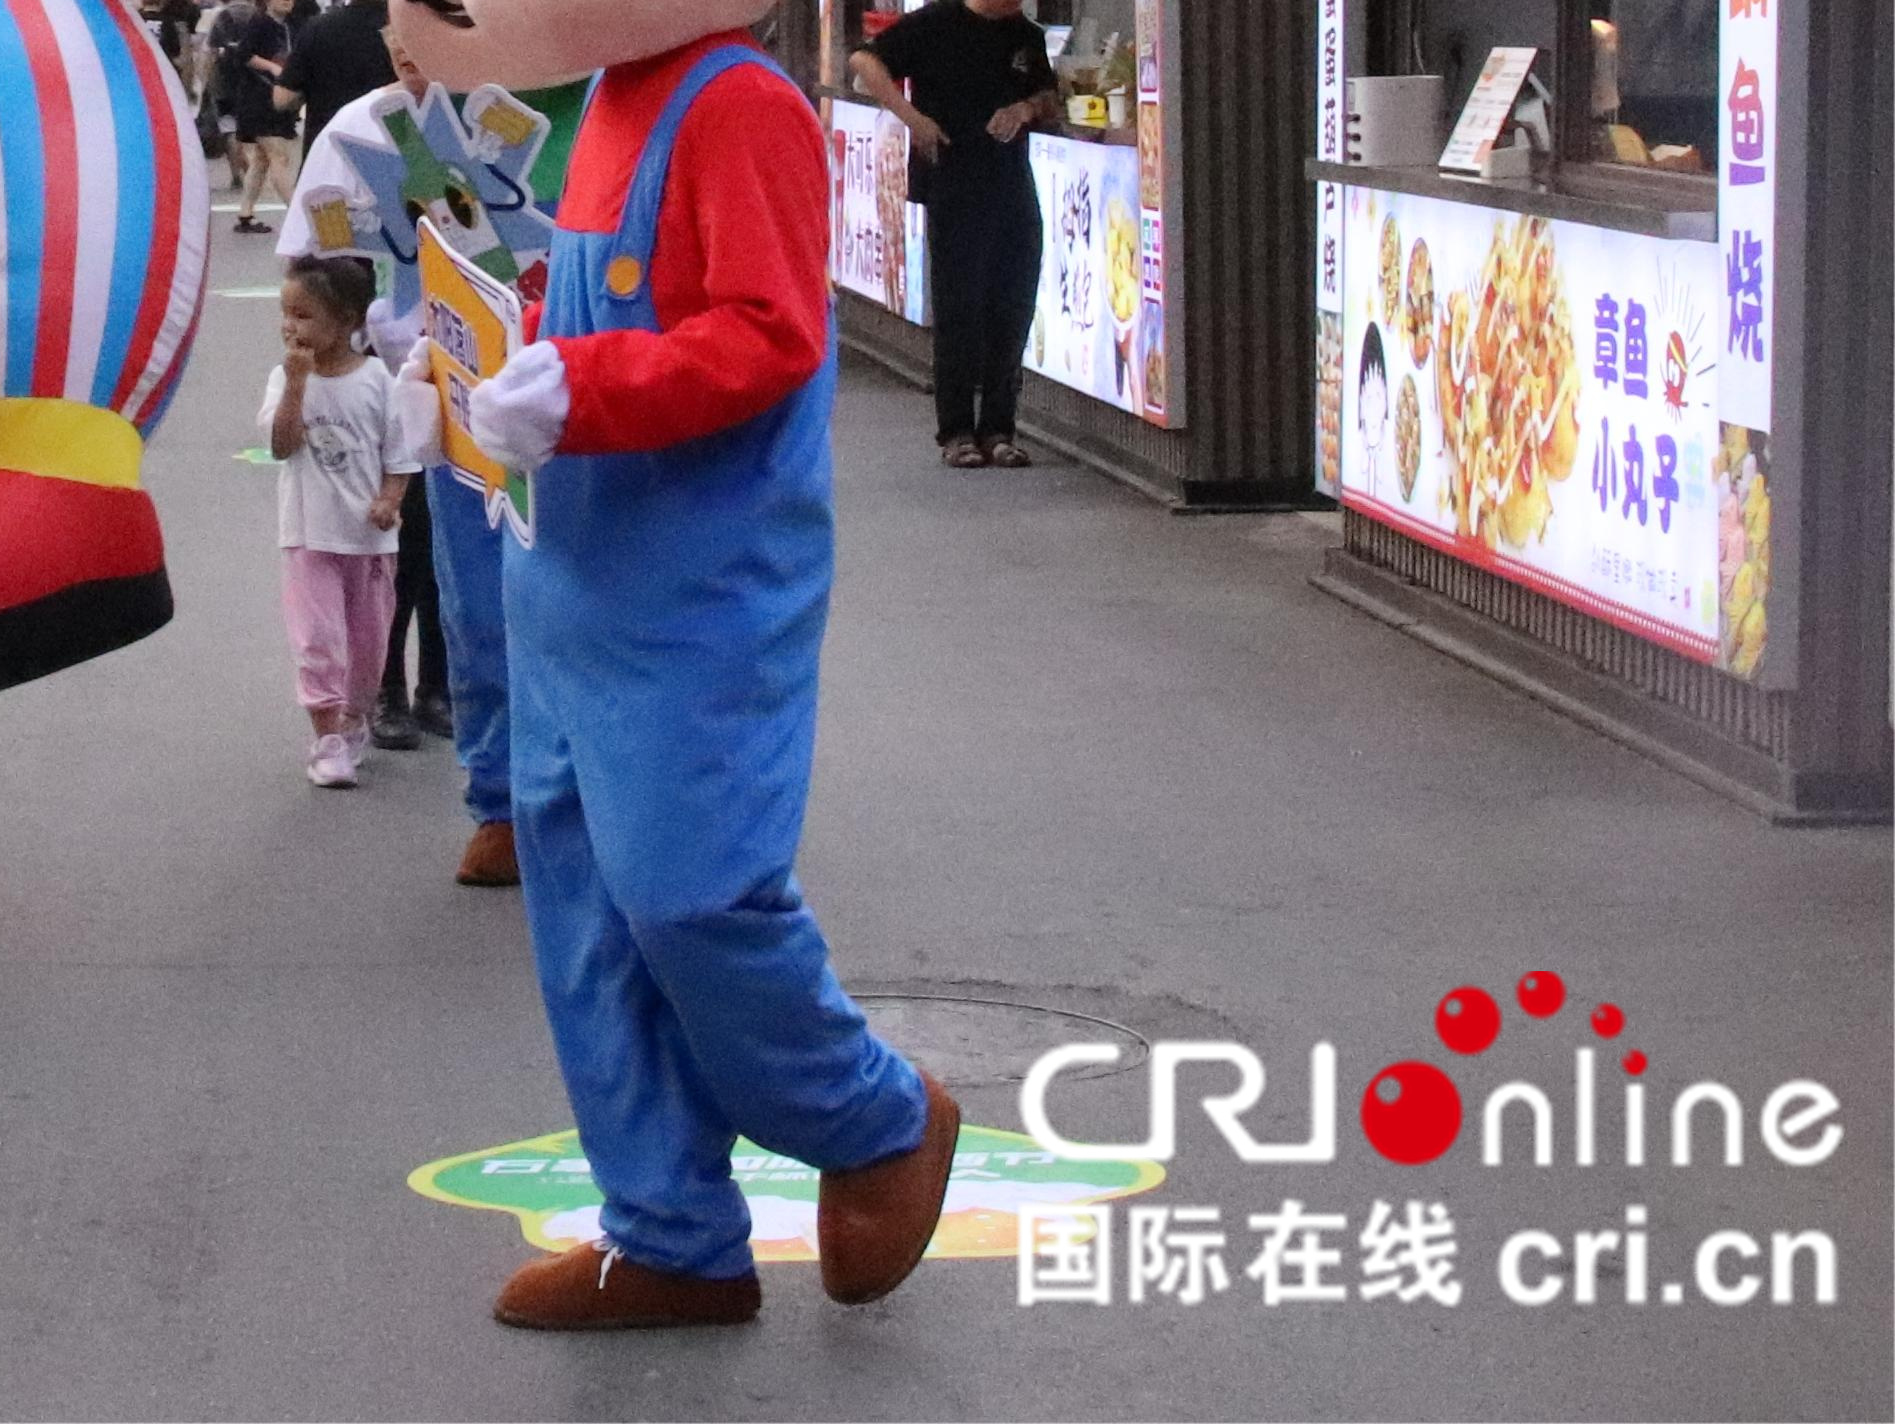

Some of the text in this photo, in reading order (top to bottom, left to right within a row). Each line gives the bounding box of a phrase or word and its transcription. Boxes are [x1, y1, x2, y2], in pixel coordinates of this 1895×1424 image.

[1592, 292, 1650, 400] 章鱼
[1591, 416, 1680, 535] 小丸子
